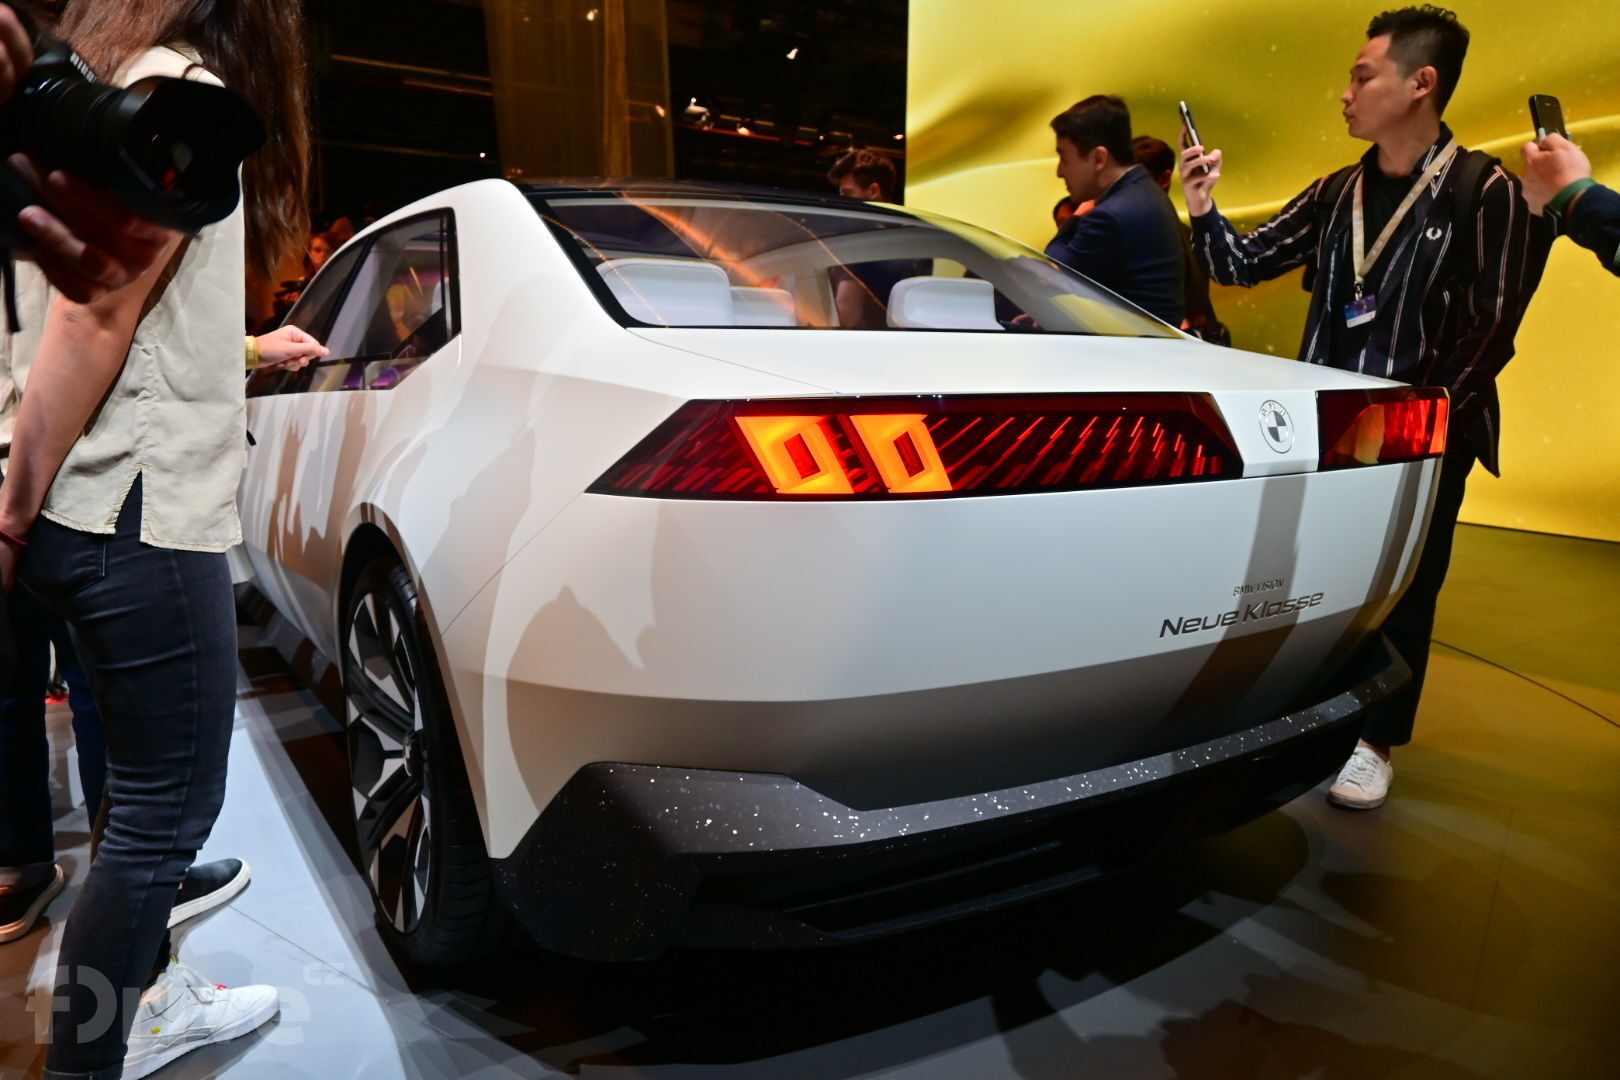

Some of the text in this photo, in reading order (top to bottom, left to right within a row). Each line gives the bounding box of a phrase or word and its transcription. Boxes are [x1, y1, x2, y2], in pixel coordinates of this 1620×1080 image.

[1233, 579, 1284, 597] BMW VISION
[1159, 592, 1324, 638] Neue Klasse
